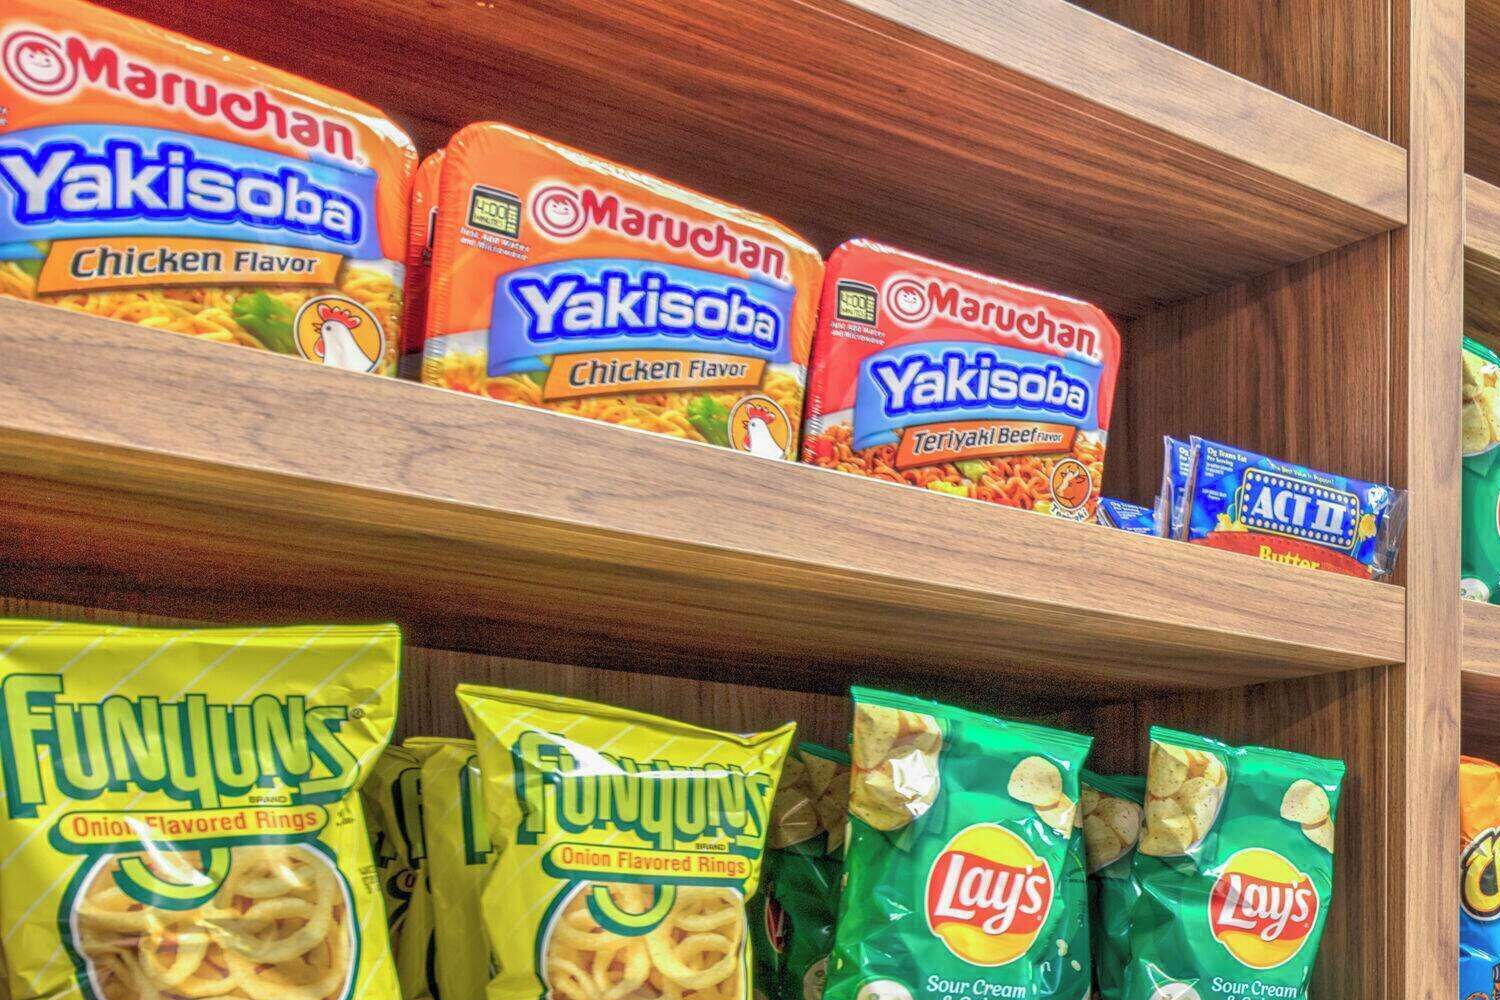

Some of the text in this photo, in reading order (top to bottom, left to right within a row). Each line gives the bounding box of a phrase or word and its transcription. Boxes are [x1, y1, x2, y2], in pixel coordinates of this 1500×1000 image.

[65, 38, 354, 161] Maruchan
[1, 148, 354, 236] Yakisoba
[581, 188, 785, 280] Maruchan
[70, 246, 318, 279] Chicken Flavor
[519, 275, 776, 342] Yakisoba
[928, 282, 1095, 355] Maruchan
[569, 356, 748, 387] Chicken Flavor
[876, 356, 1085, 411] Yakisoba
[913, 427, 995, 454] Teriyaki
[998, 426, 1038, 445] Beef
[1250, 486, 1312, 527] ACT
[146, 811, 247, 836] Flavored
[259, 810, 317, 832] Rings
[561, 846, 746, 877] Onion Flavored Rings
[934, 854, 1046, 935] Lay's
[1217, 873, 1312, 942] Lay's
[927, 975, 1026, 1000] Sour Cream
[1211, 977, 1297, 998] Sour Cream
